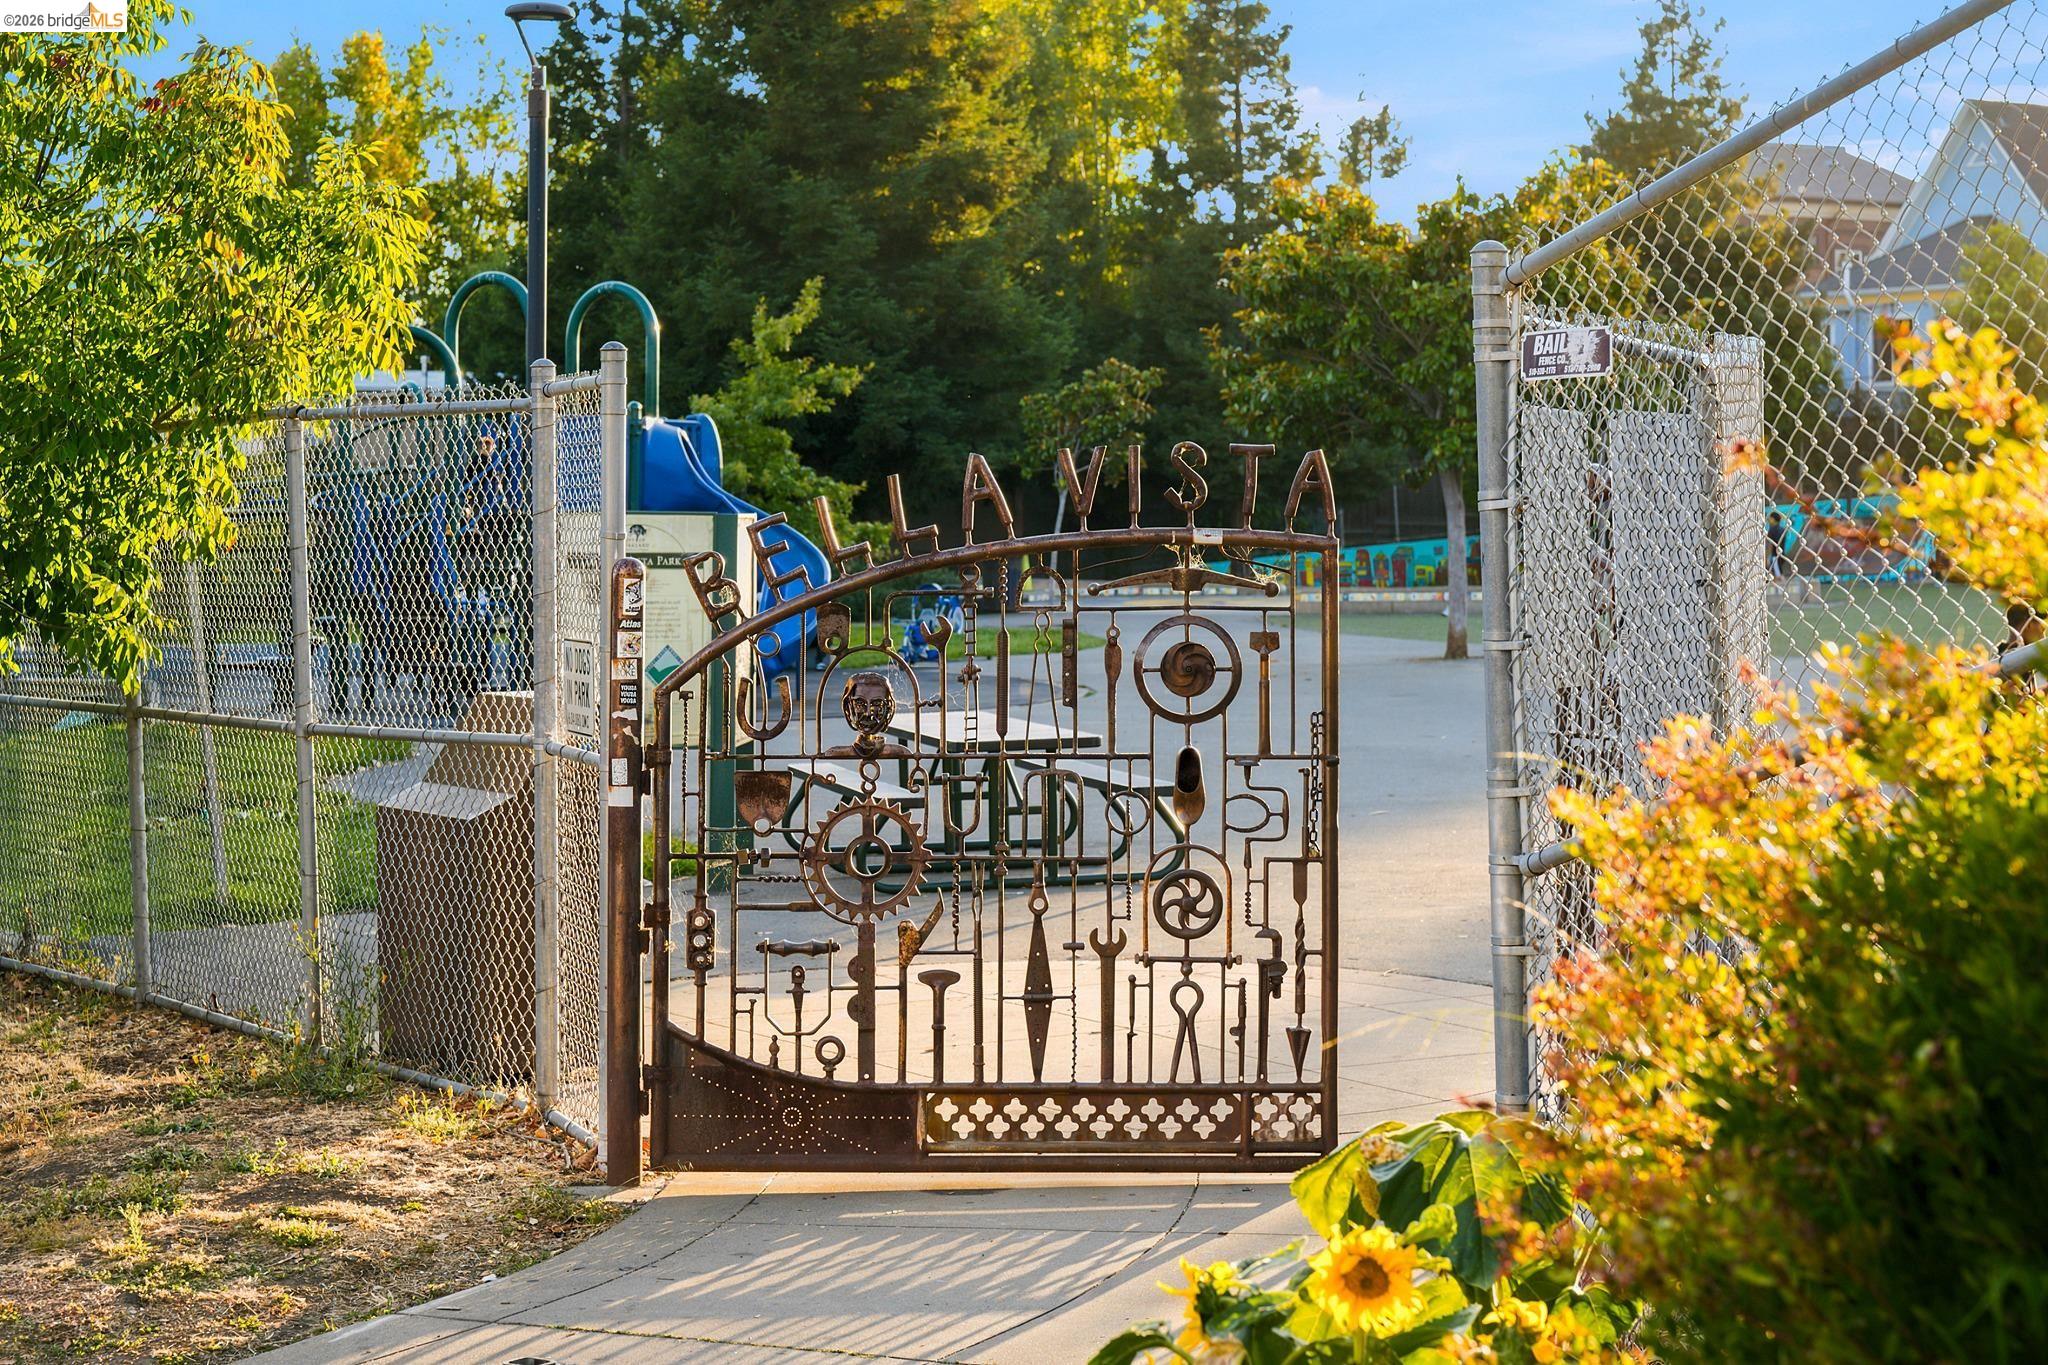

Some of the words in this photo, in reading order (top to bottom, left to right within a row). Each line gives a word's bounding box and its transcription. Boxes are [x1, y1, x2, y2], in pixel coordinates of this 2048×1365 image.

[1538, 355, 1557, 366] FENCE
[683, 452, 1015, 625] BELLA
[1057, 441, 1337, 522] VISTA
[619, 619, 642, 629] Atlas
[574, 648, 591, 675] DOGS
[574, 681, 591, 709] PARK
